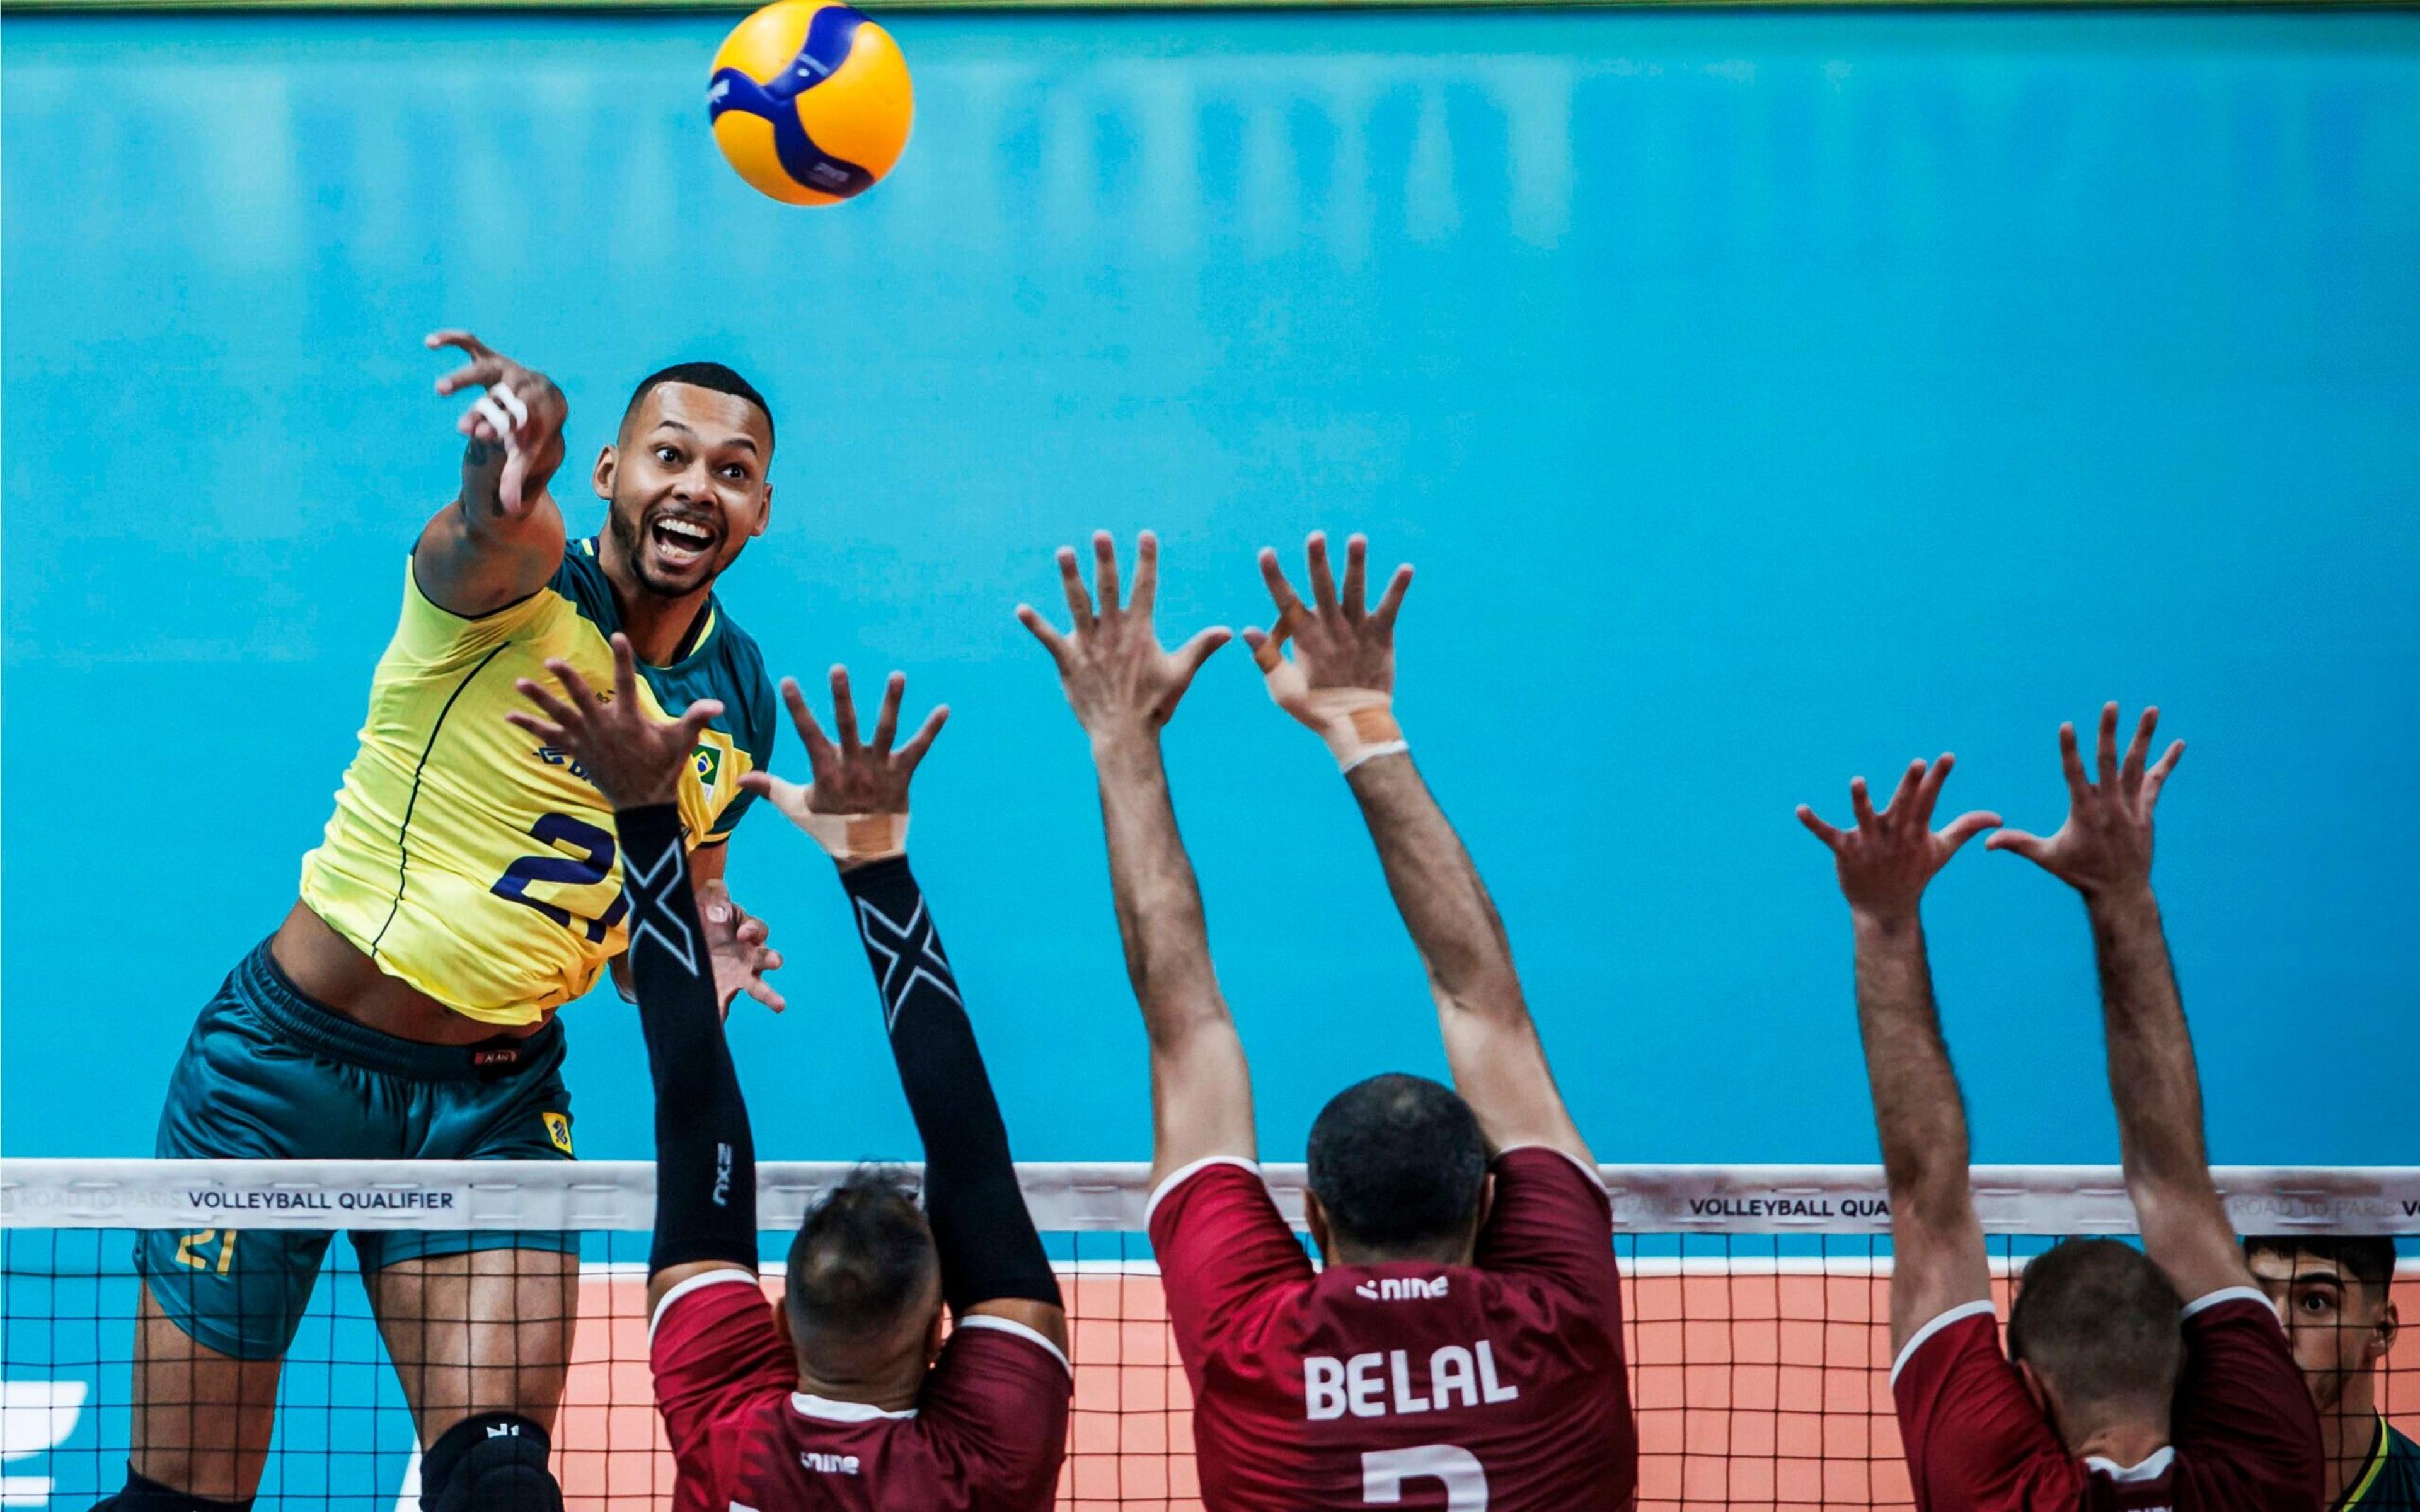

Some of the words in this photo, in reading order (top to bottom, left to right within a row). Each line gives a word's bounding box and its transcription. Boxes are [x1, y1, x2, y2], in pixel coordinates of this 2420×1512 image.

[189, 1191, 332, 1210] VOLLEYBALL
[338, 1192, 454, 1210] QUALIFIER
[1690, 1198, 1834, 1217] VOLLEYBALL
[1303, 1339, 1519, 1421] BELAL
